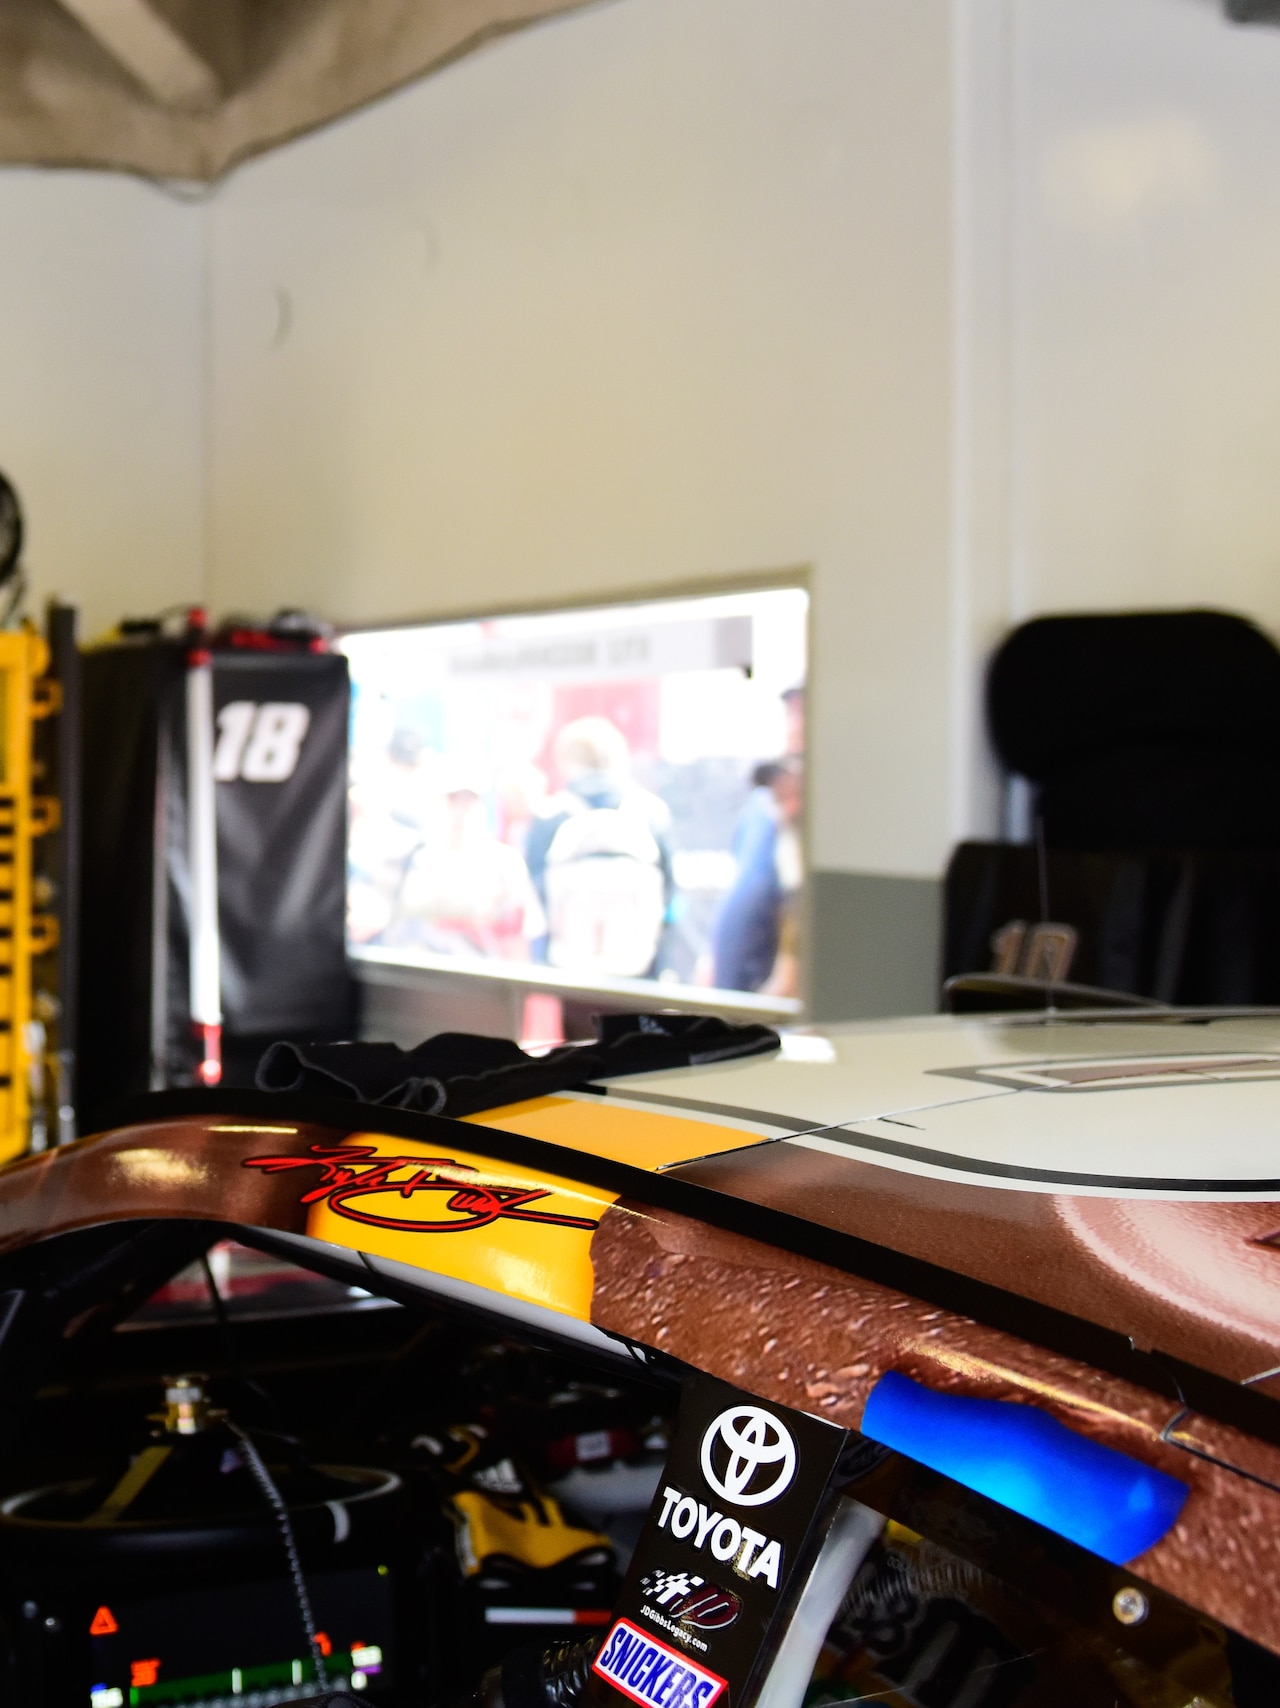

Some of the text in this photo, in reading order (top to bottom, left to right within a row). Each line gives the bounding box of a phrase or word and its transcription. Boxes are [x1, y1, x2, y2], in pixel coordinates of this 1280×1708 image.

[215, 700, 311, 783] 18
[657, 1486, 783, 1590] TOYOTA
[599, 1626, 715, 1708] SNICKERS
[639, 1604, 709, 1653] JDGibbsLegacy.com
